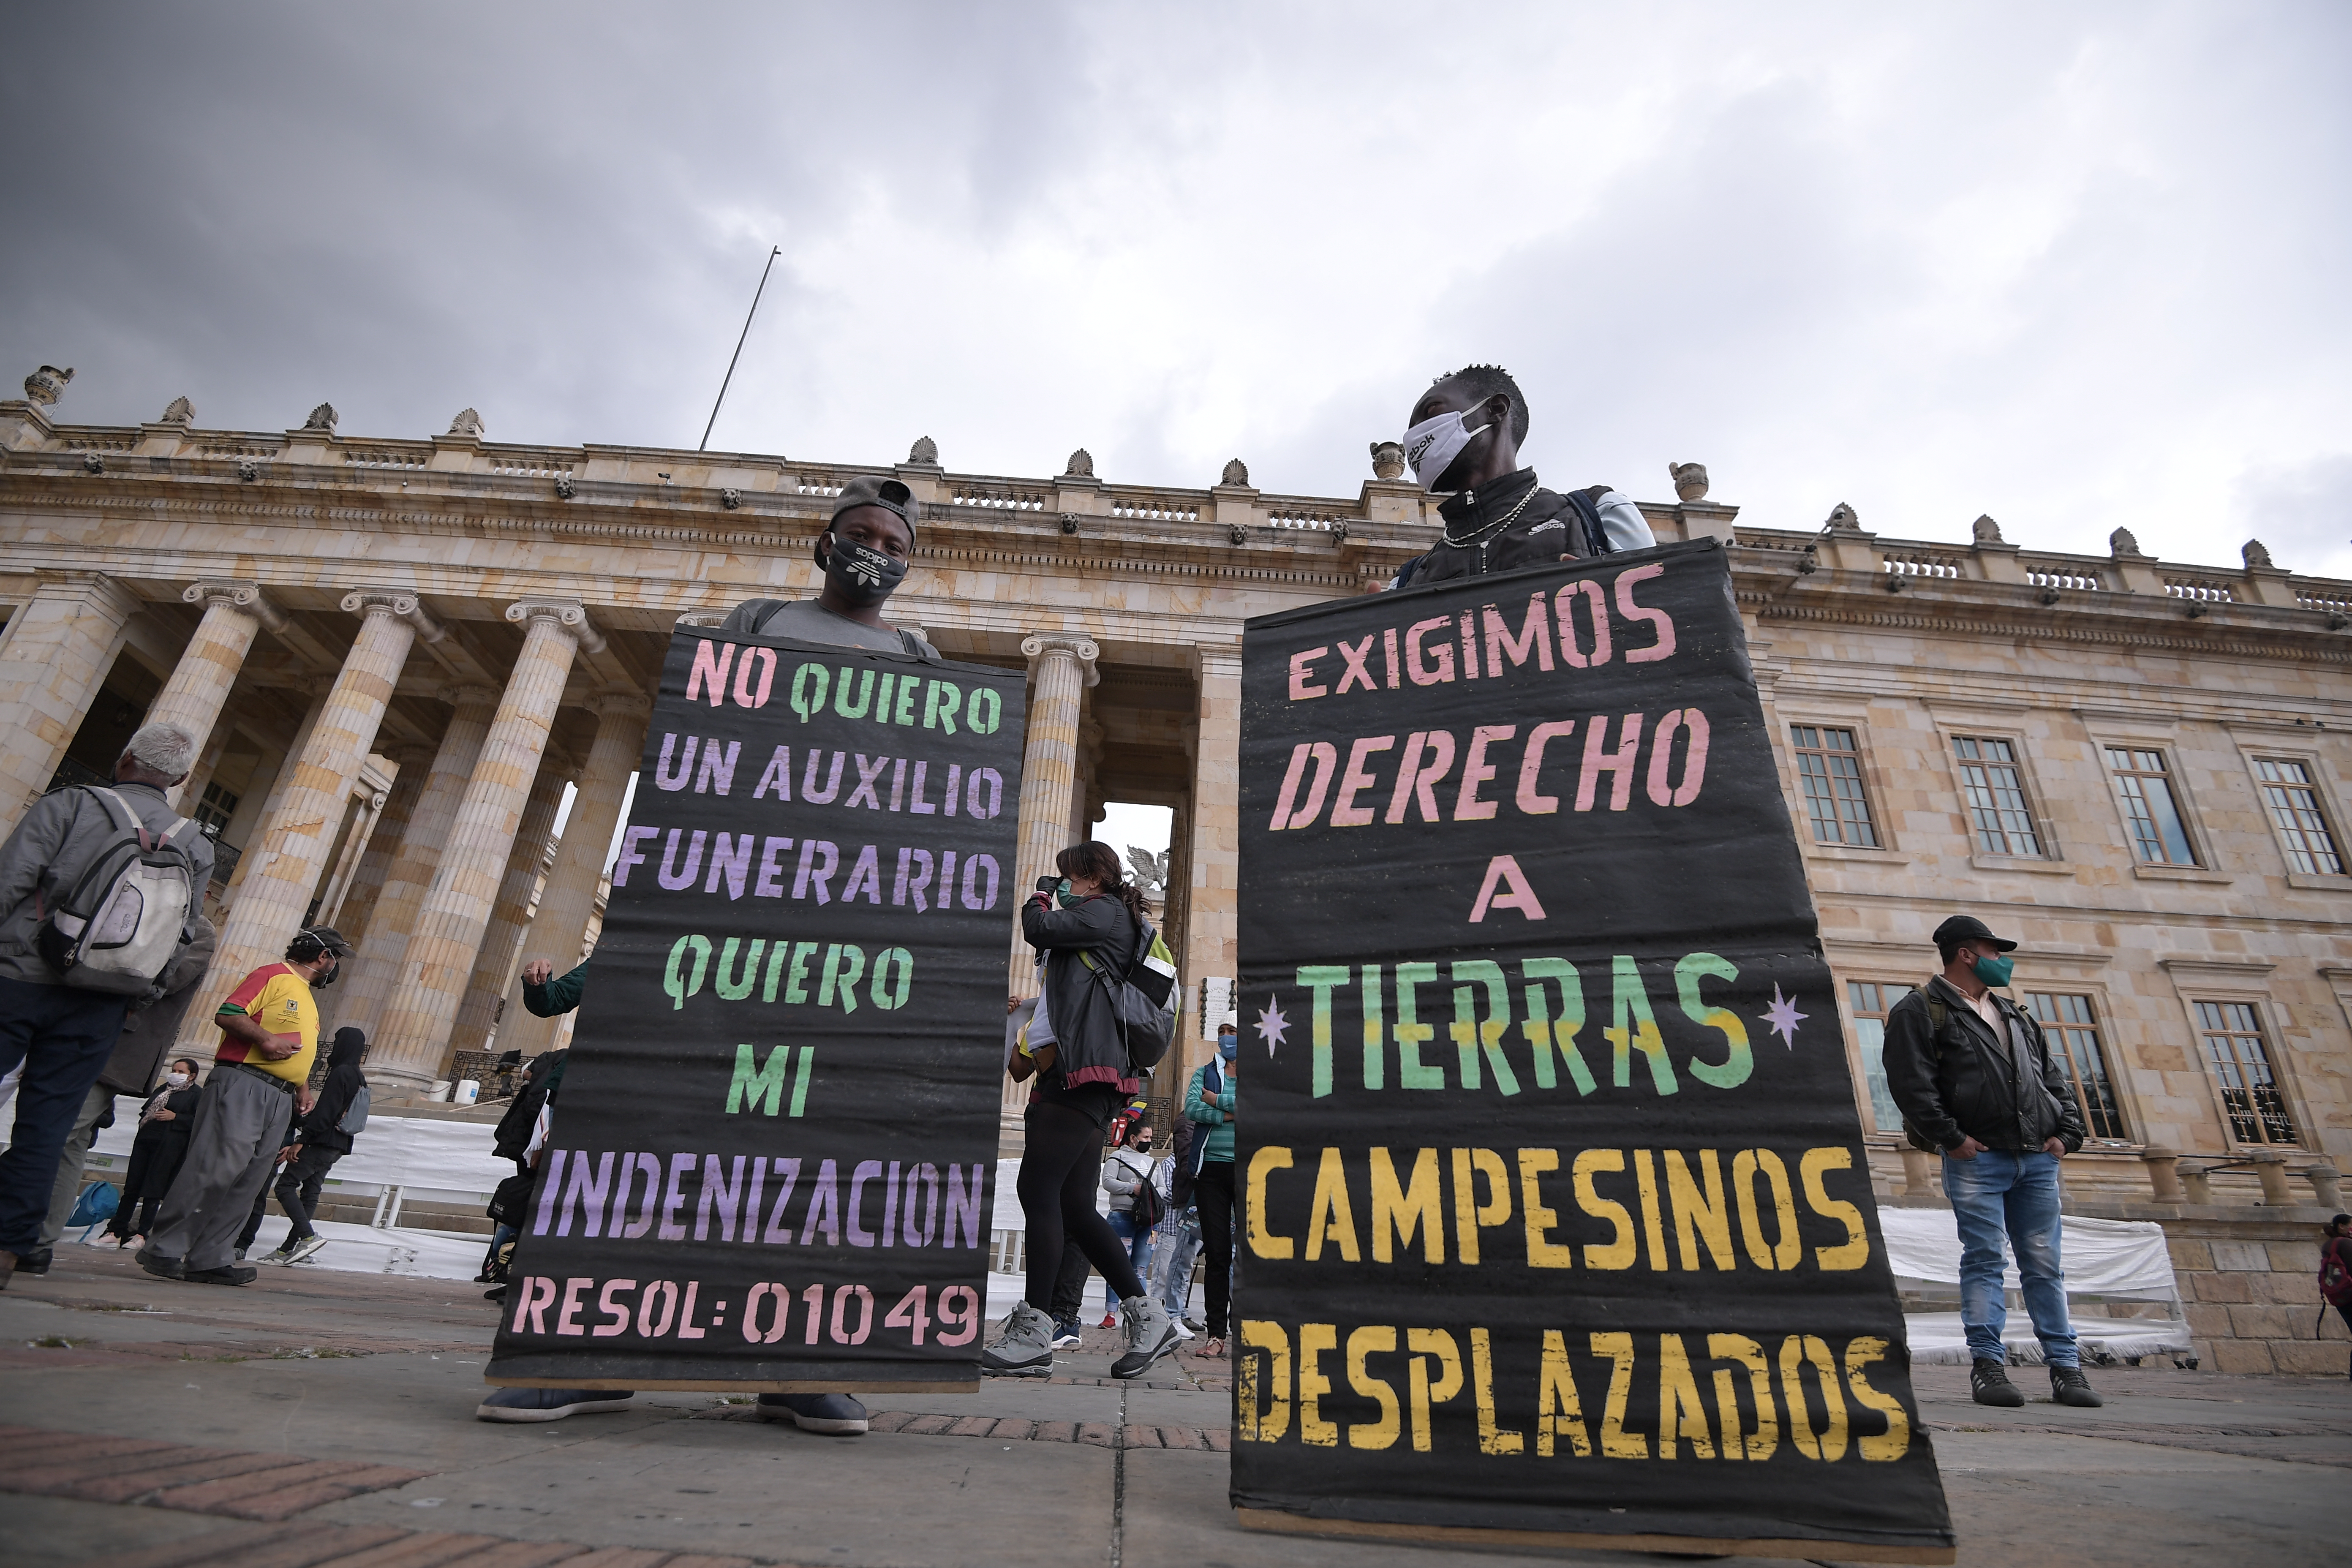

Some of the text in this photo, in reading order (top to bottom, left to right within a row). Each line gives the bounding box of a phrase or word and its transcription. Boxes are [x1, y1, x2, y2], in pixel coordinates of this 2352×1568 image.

[1408, 434, 1435, 465] ebok
[856, 547, 888, 566] adidas
[1289, 563, 1676, 701] EXIGIMOS
[686, 640, 1002, 735] NO QUIERO
[656, 733, 1003, 819] UN AUXILIO
[1269, 708, 1710, 830] DERECHO
[612, 825, 1000, 913] FUNERARIO
[1469, 855, 1546, 923] A
[664, 934, 913, 1013] QUIERO
[1297, 953, 1754, 1098] TIERRAS
[726, 1044, 814, 1117] MI
[533, 1149, 983, 1250] INDENIZACION
[1246, 1146, 1870, 1272] CAMPESINOS
[512, 1277, 978, 1347] RESOL: 01049
[1239, 1320, 1909, 1462] DESPLAZADOS
